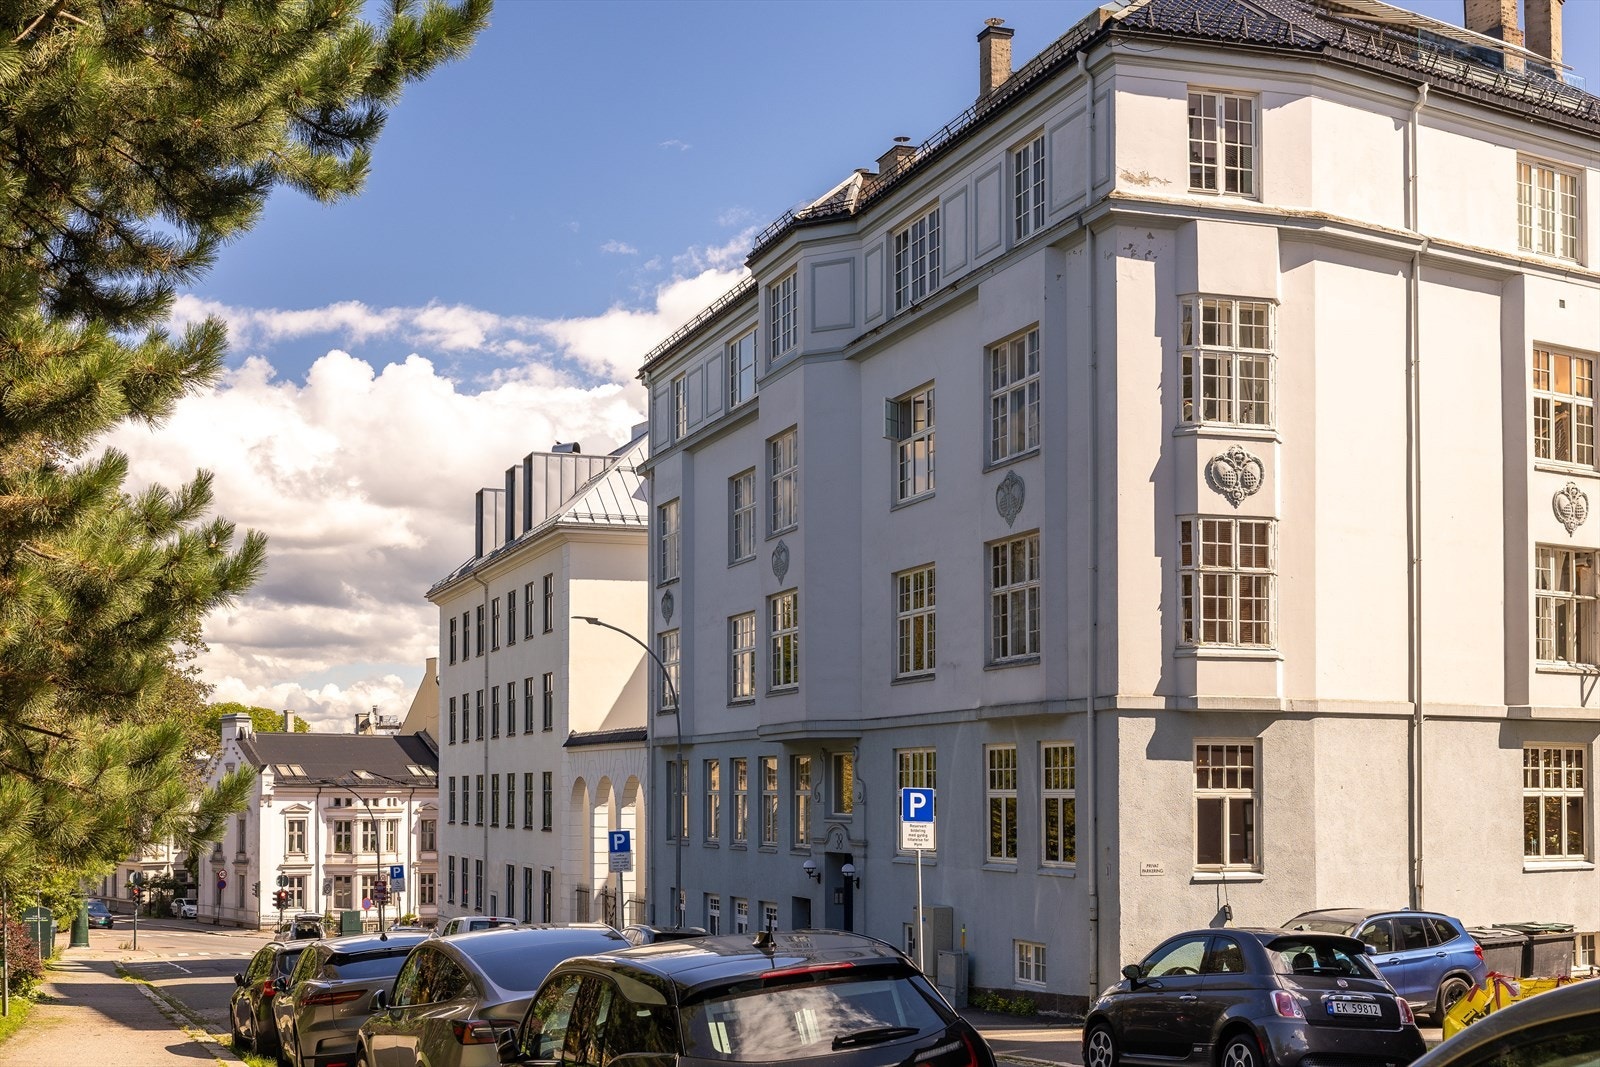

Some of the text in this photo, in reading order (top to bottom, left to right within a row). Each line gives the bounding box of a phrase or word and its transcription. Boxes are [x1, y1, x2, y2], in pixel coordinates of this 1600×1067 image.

[910, 792, 926, 817] P
[613, 834, 625, 850] P
[393, 867, 401, 878] P
[1336, 1003, 1379, 1014] EK 59812
